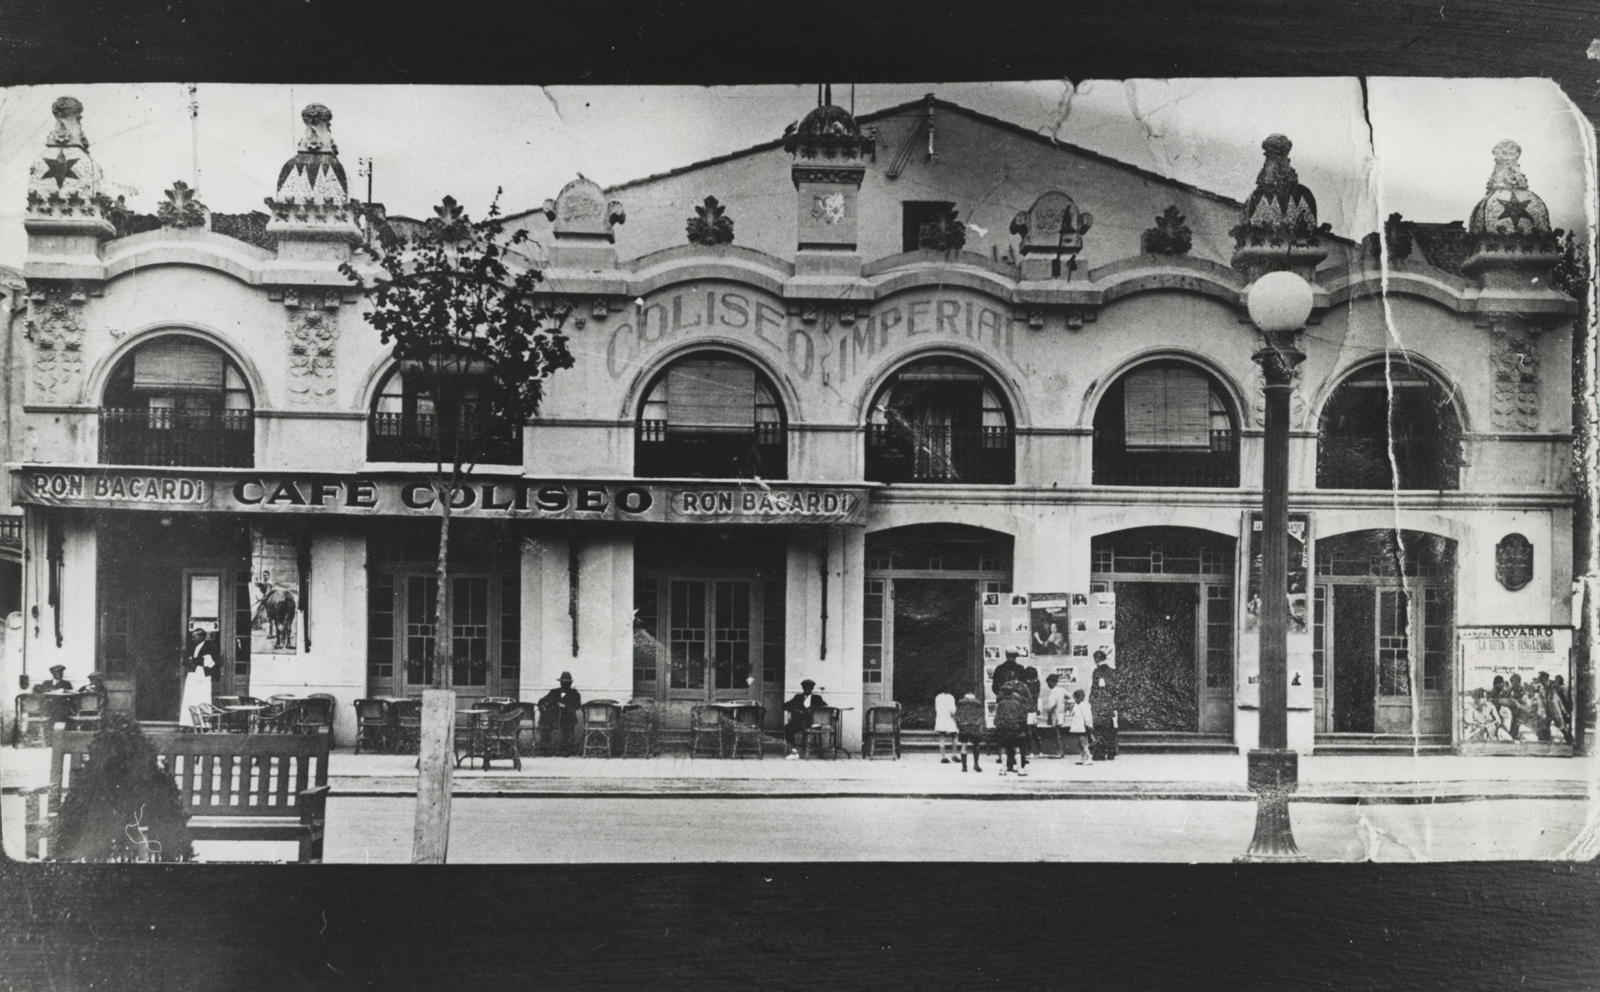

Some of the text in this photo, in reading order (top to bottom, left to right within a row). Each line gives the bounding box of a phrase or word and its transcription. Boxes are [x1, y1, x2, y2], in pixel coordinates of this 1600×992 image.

[606, 291, 1030, 384] COLISEO IMPERIAL
[32, 473, 85, 500] RON
[232, 478, 381, 510] CAFE
[402, 483, 654, 514] COLISEO
[682, 491, 733, 514] RON
[1492, 627, 1553, 637] NOVARRO
